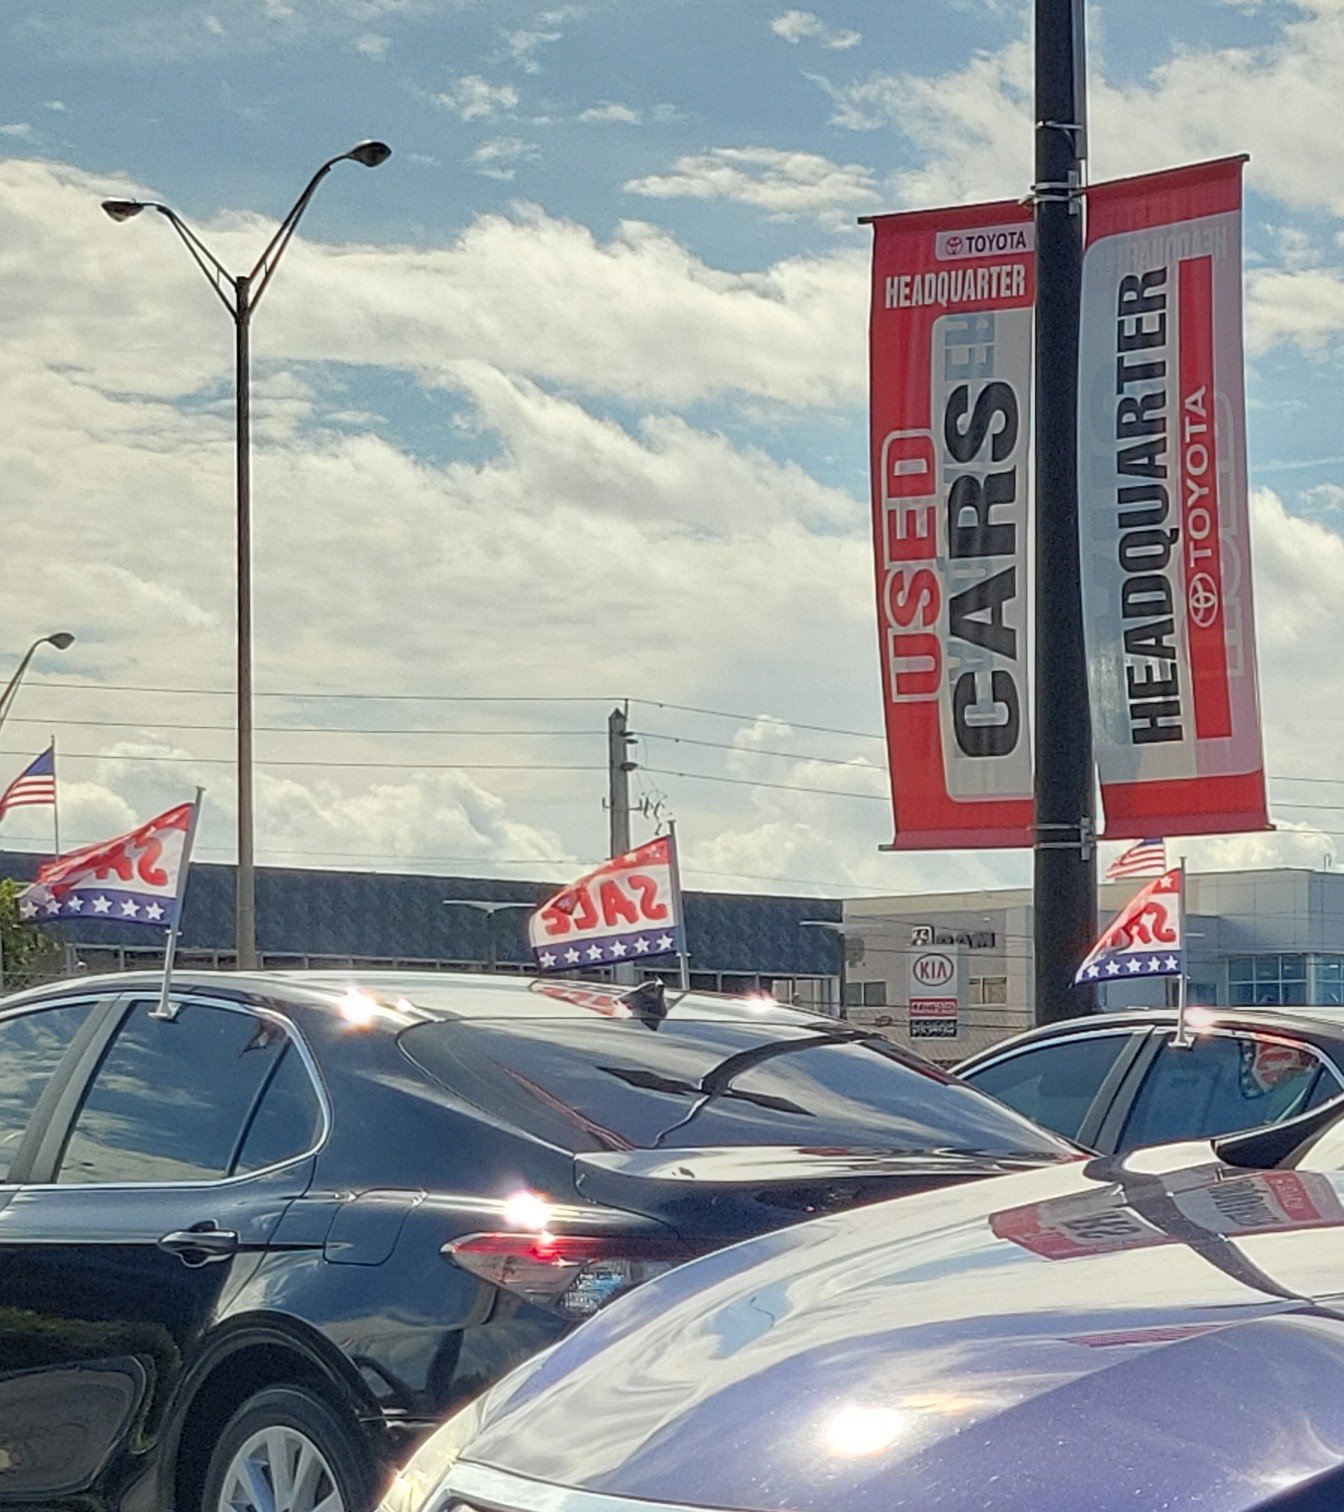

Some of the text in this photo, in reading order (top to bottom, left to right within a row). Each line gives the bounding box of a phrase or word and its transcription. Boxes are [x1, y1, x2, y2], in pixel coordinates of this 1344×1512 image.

[886, 264, 1026, 308] HEADQUARTER
[965, 231, 1027, 254] TOYOTA
[886, 434, 942, 697] USED
[1117, 266, 1184, 745] HEADQUARTER
[1184, 386, 1213, 568] TOYOTA
[945, 381, 1020, 758] CARS
[920, 961, 947, 979] KIA
